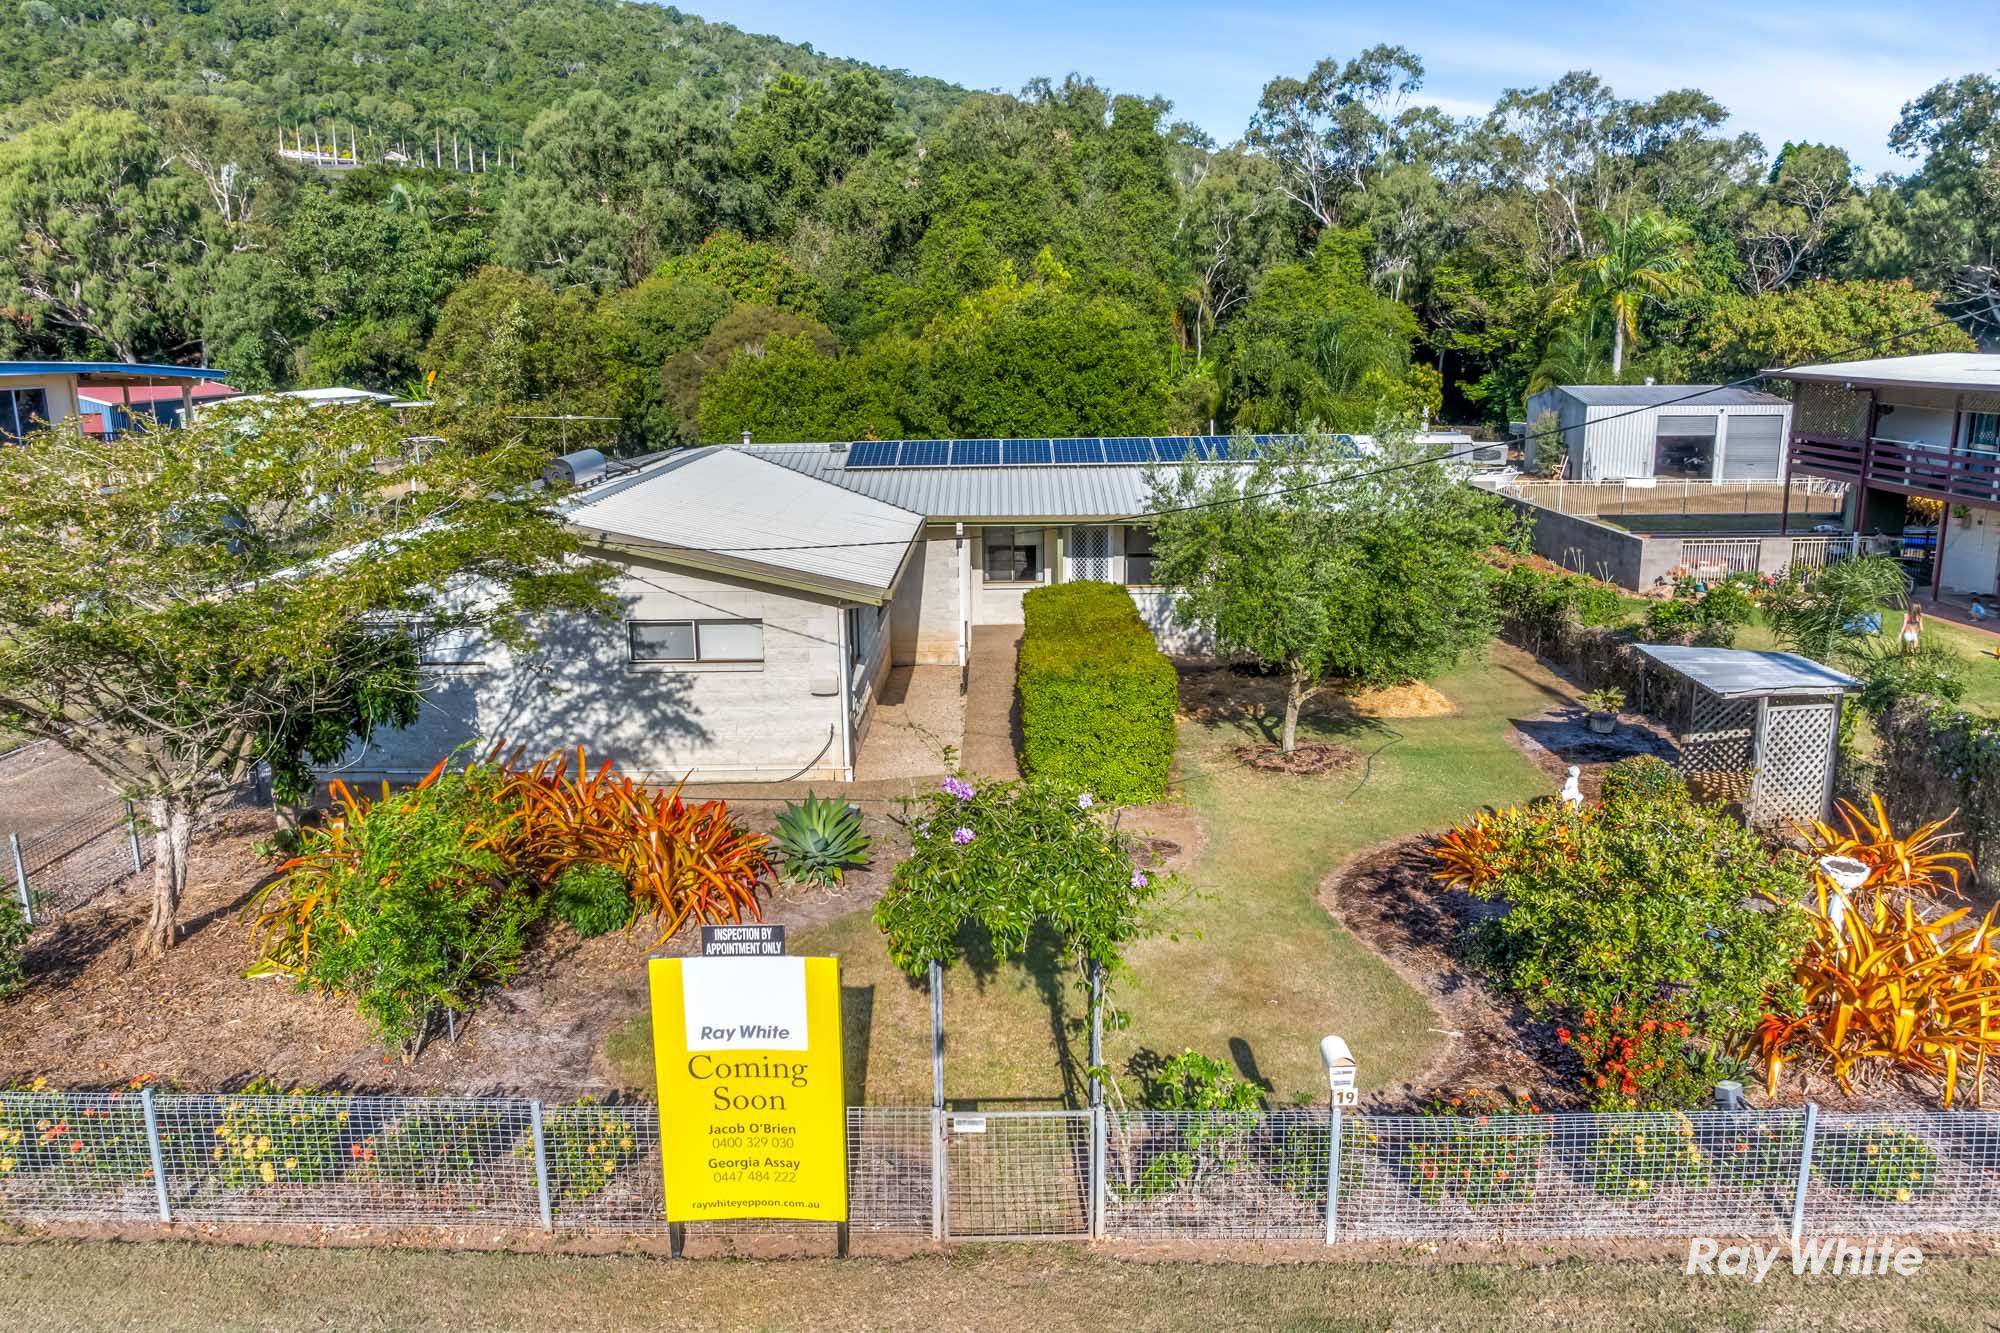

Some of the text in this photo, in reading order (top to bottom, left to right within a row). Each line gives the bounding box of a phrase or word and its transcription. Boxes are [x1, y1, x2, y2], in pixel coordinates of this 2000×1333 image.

[714, 927, 772, 941] INSPECTION BY
[705, 941, 782, 955] APPOINTMENT ONLY
[700, 1024, 790, 1042] Ray White
[688, 1055, 809, 1088] Coming
[713, 1086, 786, 1111] Soon
[1337, 1092, 1354, 1104] 19
[708, 1123, 796, 1135] Jacob O'Brien
[712, 1137, 794, 1149] 0400 329 030
[708, 1157, 801, 1170] Georgia Assay
[713, 1171, 797, 1183] 0447 484 222
[692, 1199, 820, 1210] raywhiteyeppoon.com.au
